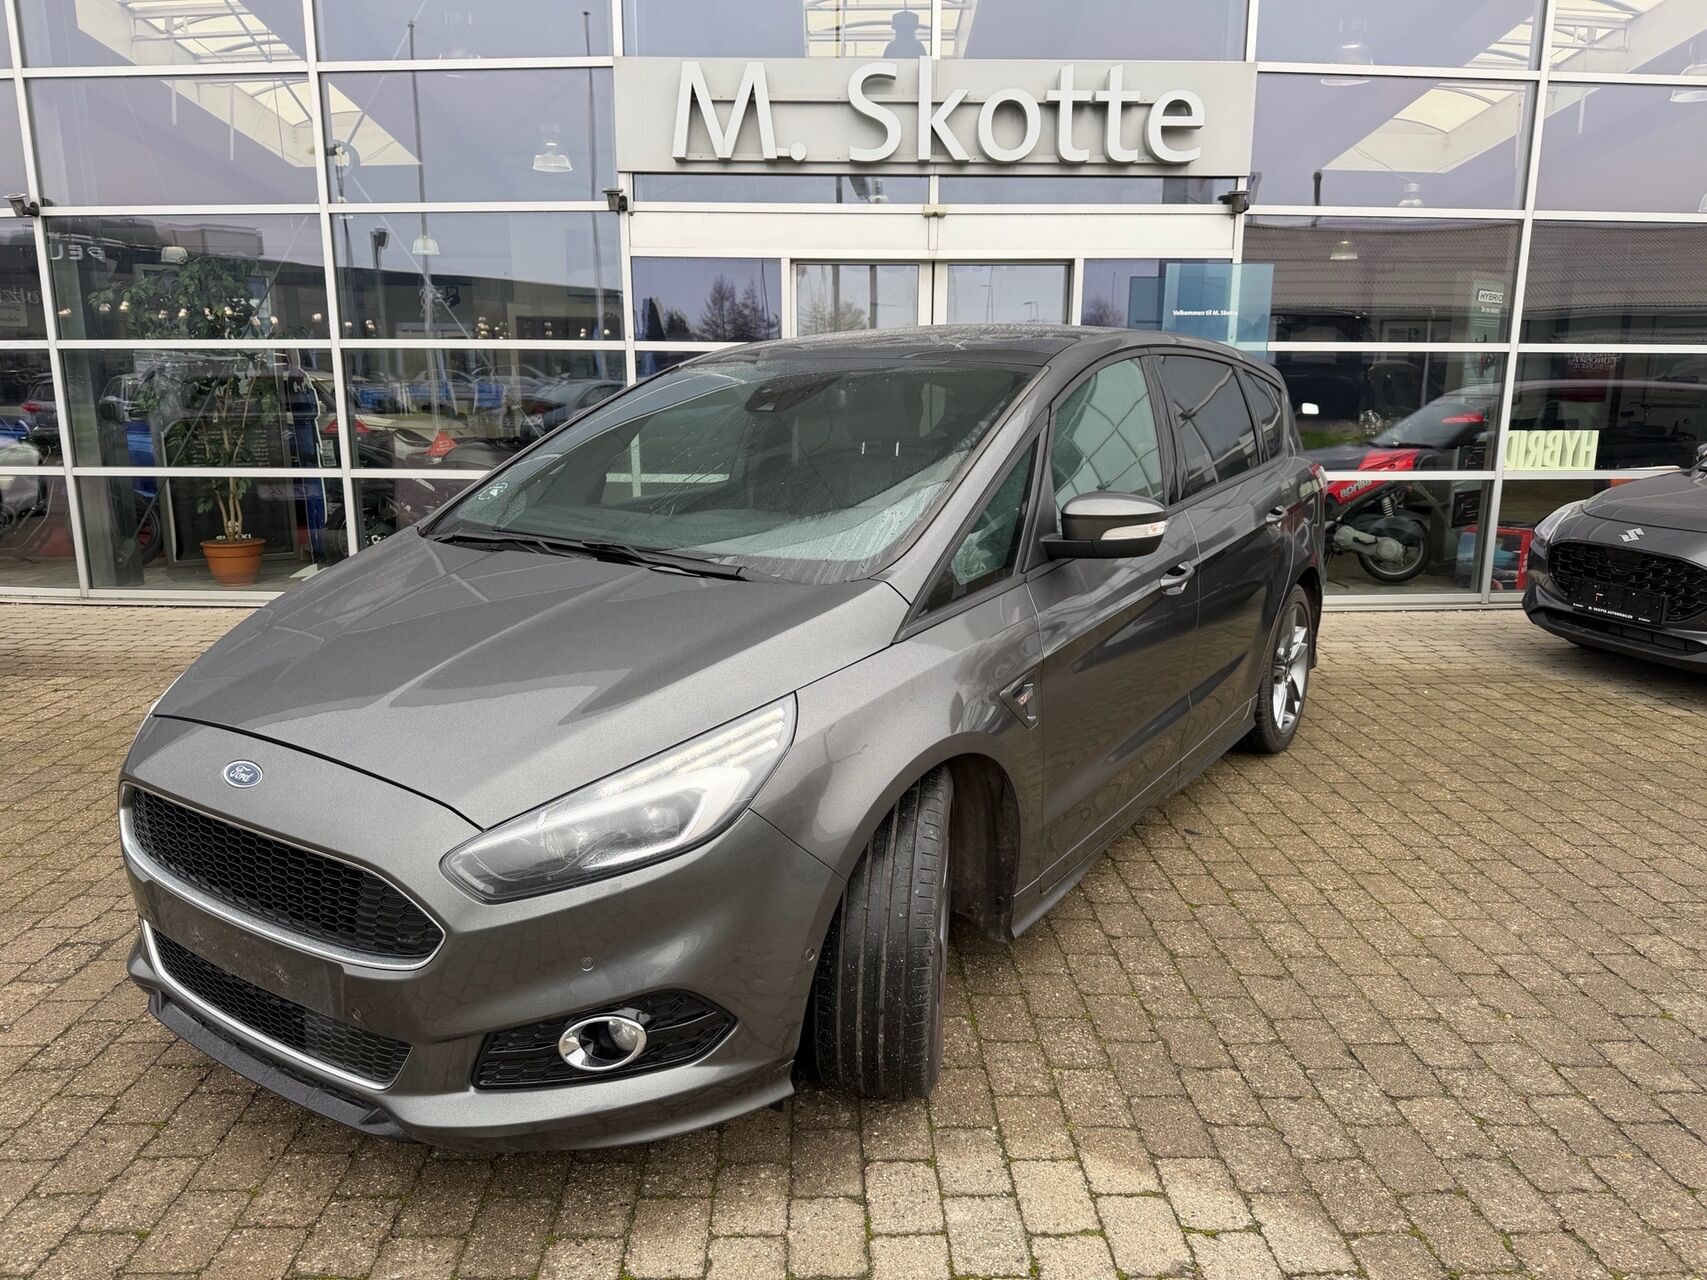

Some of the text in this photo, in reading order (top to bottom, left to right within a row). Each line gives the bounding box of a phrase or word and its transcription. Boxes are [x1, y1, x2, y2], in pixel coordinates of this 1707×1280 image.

[672, 55, 1206, 164] M. Skotte
[1480, 292, 1504, 302] HYBRID
[230, 765, 254, 782] Ford
